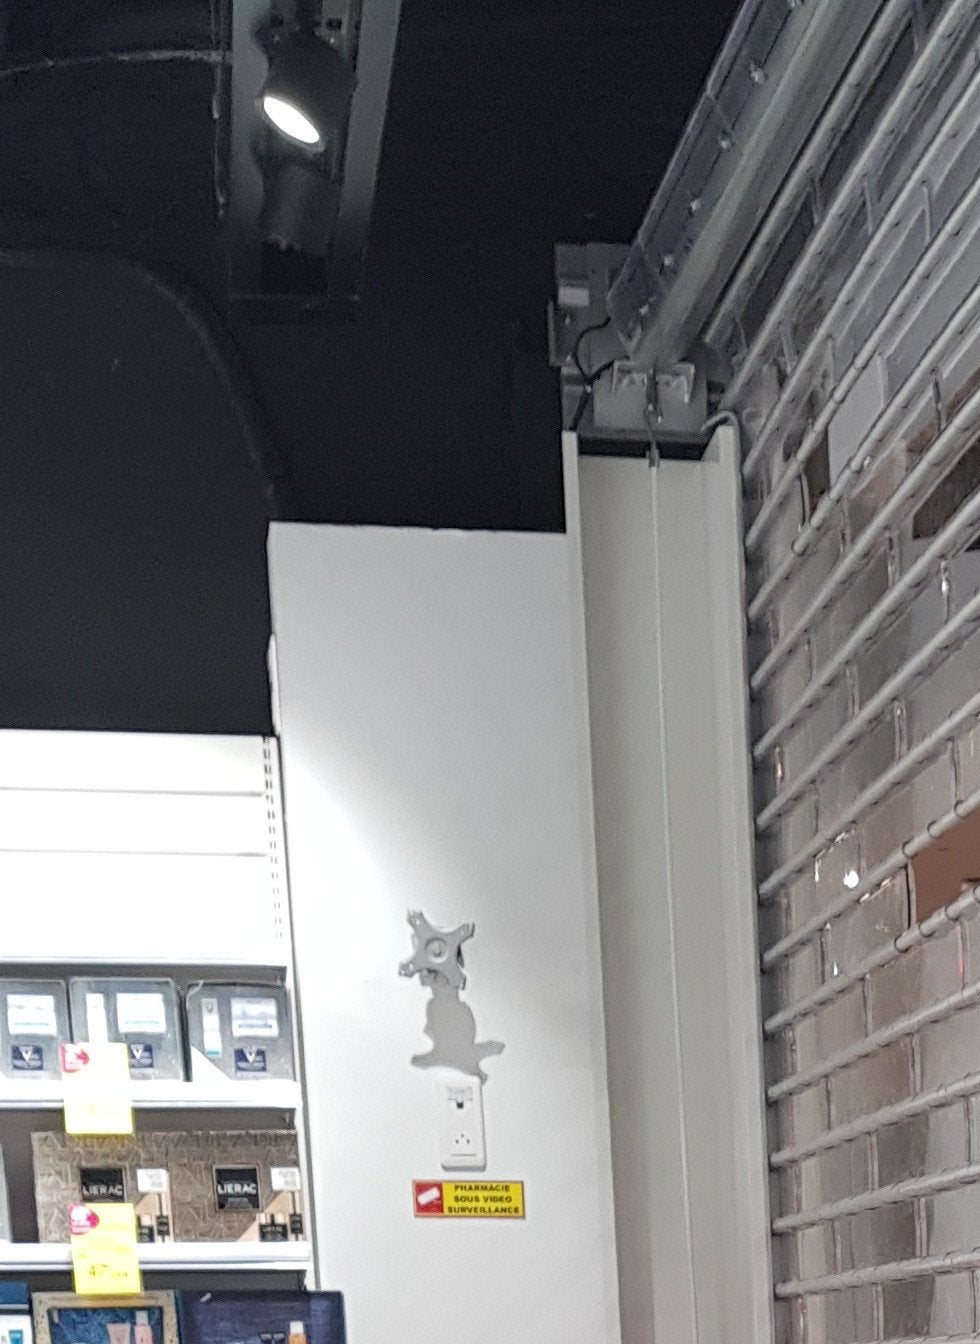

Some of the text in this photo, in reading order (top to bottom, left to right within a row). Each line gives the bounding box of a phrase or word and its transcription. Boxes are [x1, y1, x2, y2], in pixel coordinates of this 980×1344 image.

[217, 1183, 257, 1195] LIERAC
[454, 1184, 511, 1193] PHARMACIE
[453, 1195, 513, 1203] SOUS VIDEO
[447, 1206, 520, 1214] SURVEILLANCE
